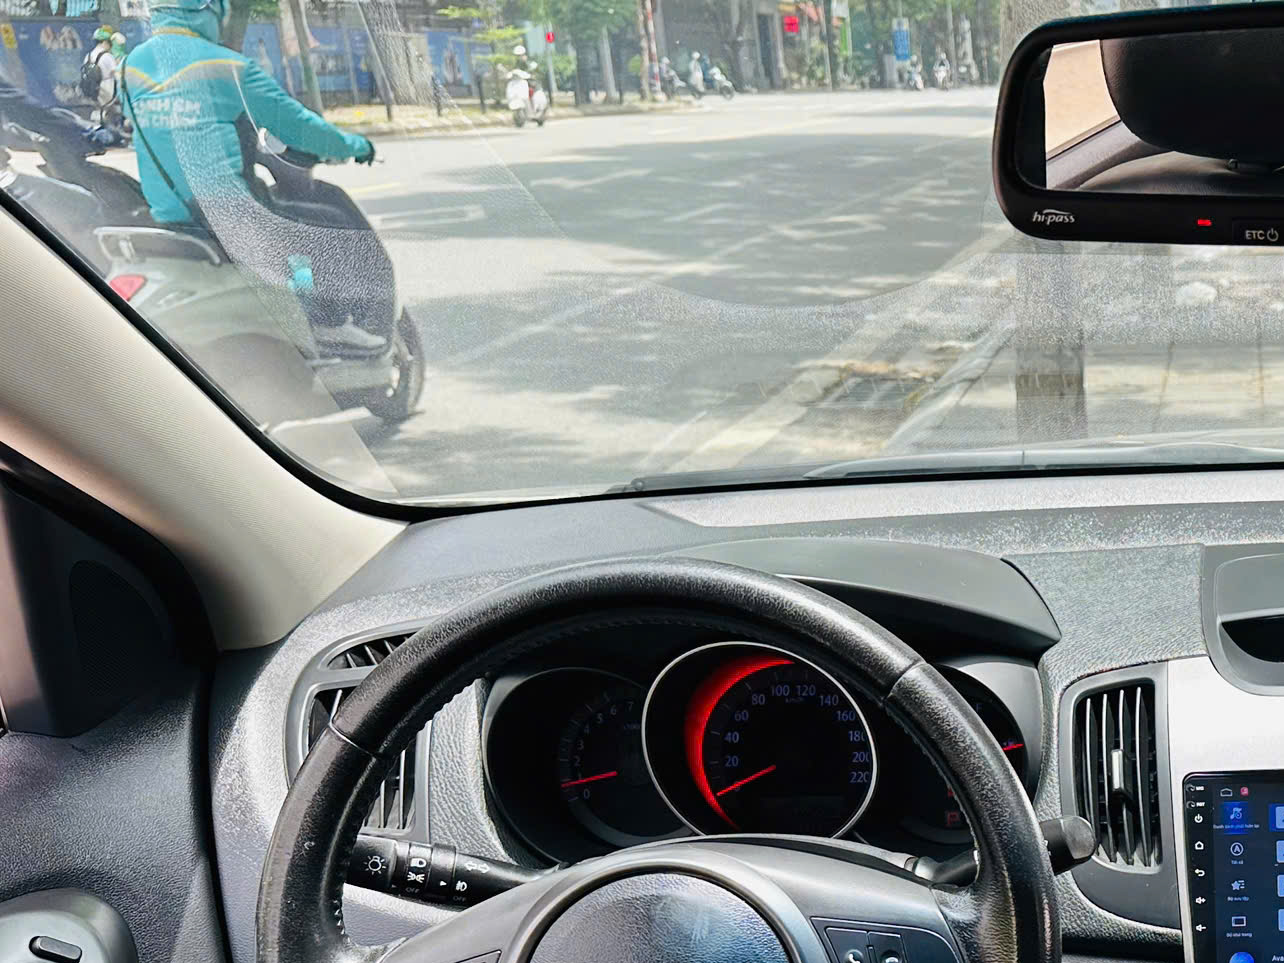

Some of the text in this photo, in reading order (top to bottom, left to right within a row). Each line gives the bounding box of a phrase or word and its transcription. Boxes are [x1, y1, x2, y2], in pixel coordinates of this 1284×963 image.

[1245, 230, 1265, 240] ETC
[771, 685, 790, 697] 100
[796, 685, 816, 696] 120
[751, 694, 766, 705] 80
[820, 695, 839, 706] 140
[734, 710, 749, 721] 60
[836, 710, 855, 721] 160
[724, 731, 740, 743] 40
[725, 755, 739, 767] 20
[1272, 954, 1284, 962] Ava
